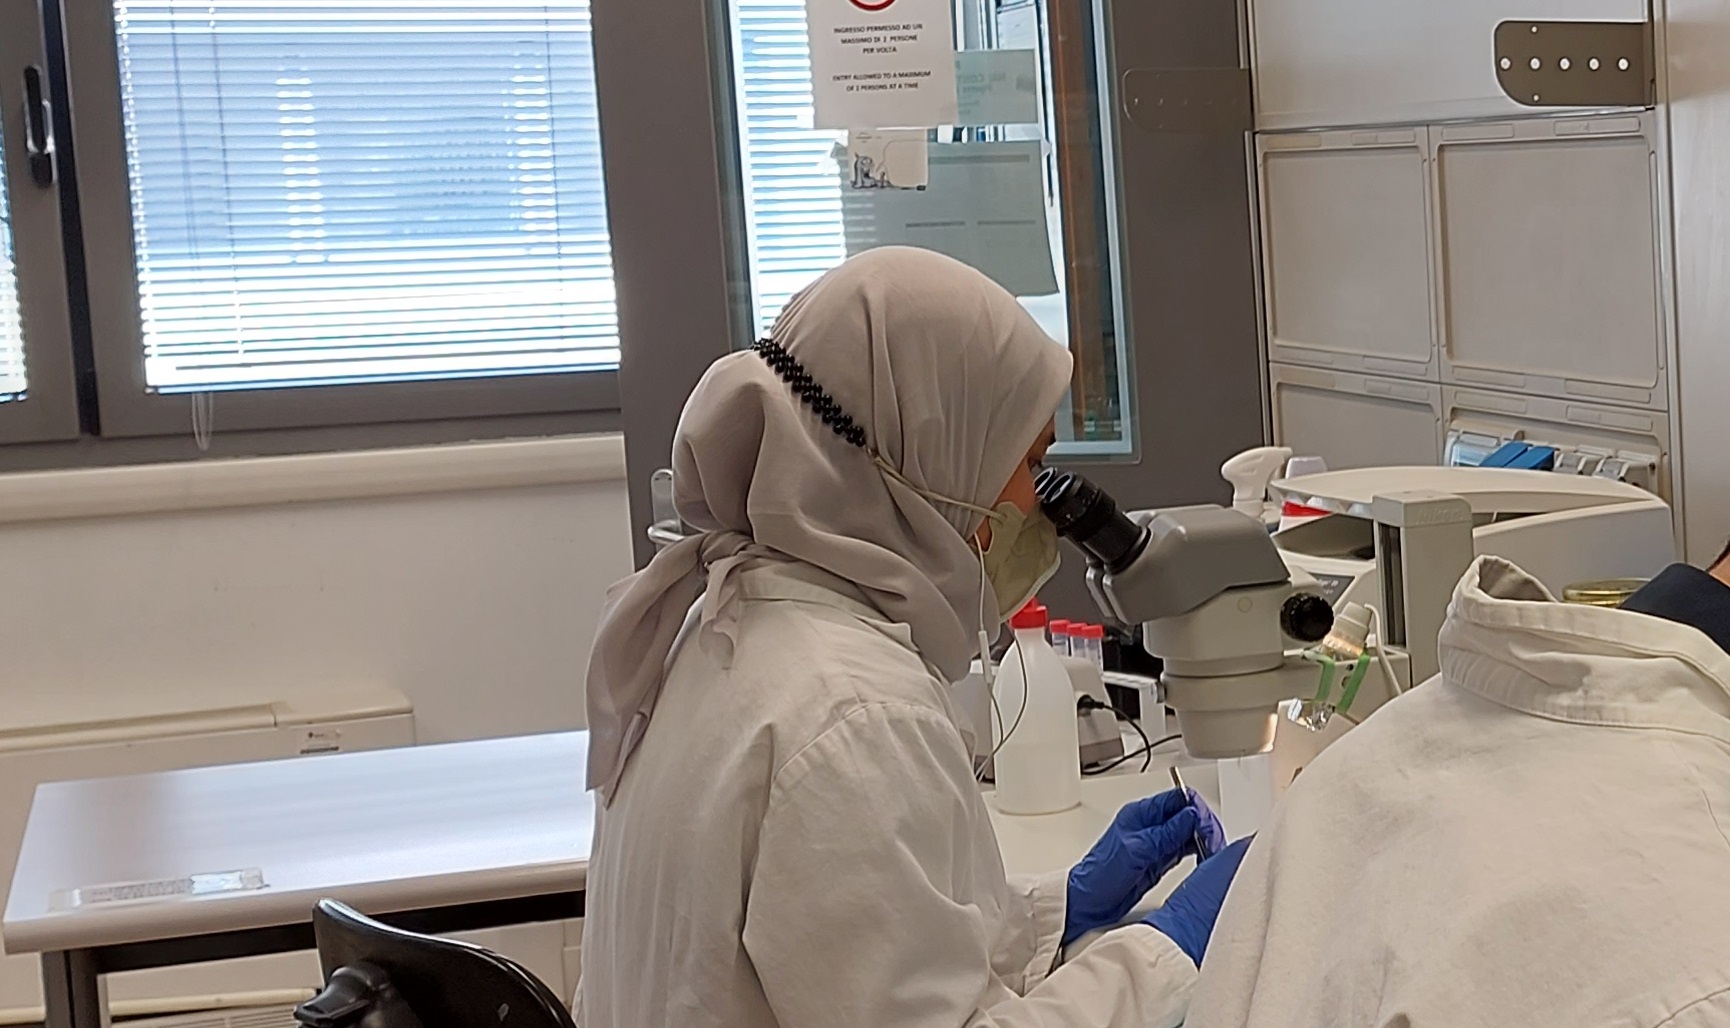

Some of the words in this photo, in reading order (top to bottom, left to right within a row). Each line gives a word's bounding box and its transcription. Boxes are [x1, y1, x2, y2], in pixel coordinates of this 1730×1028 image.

[833, 26, 865, 34] INGRESSO
[866, 24, 901, 32] PERMESSO
[889, 34, 918, 42] PERSONE
[876, 46, 898, 54] VOLTA
[853, 72, 882, 80] ALLOWED
[898, 70, 931, 78] MAXIMUM
